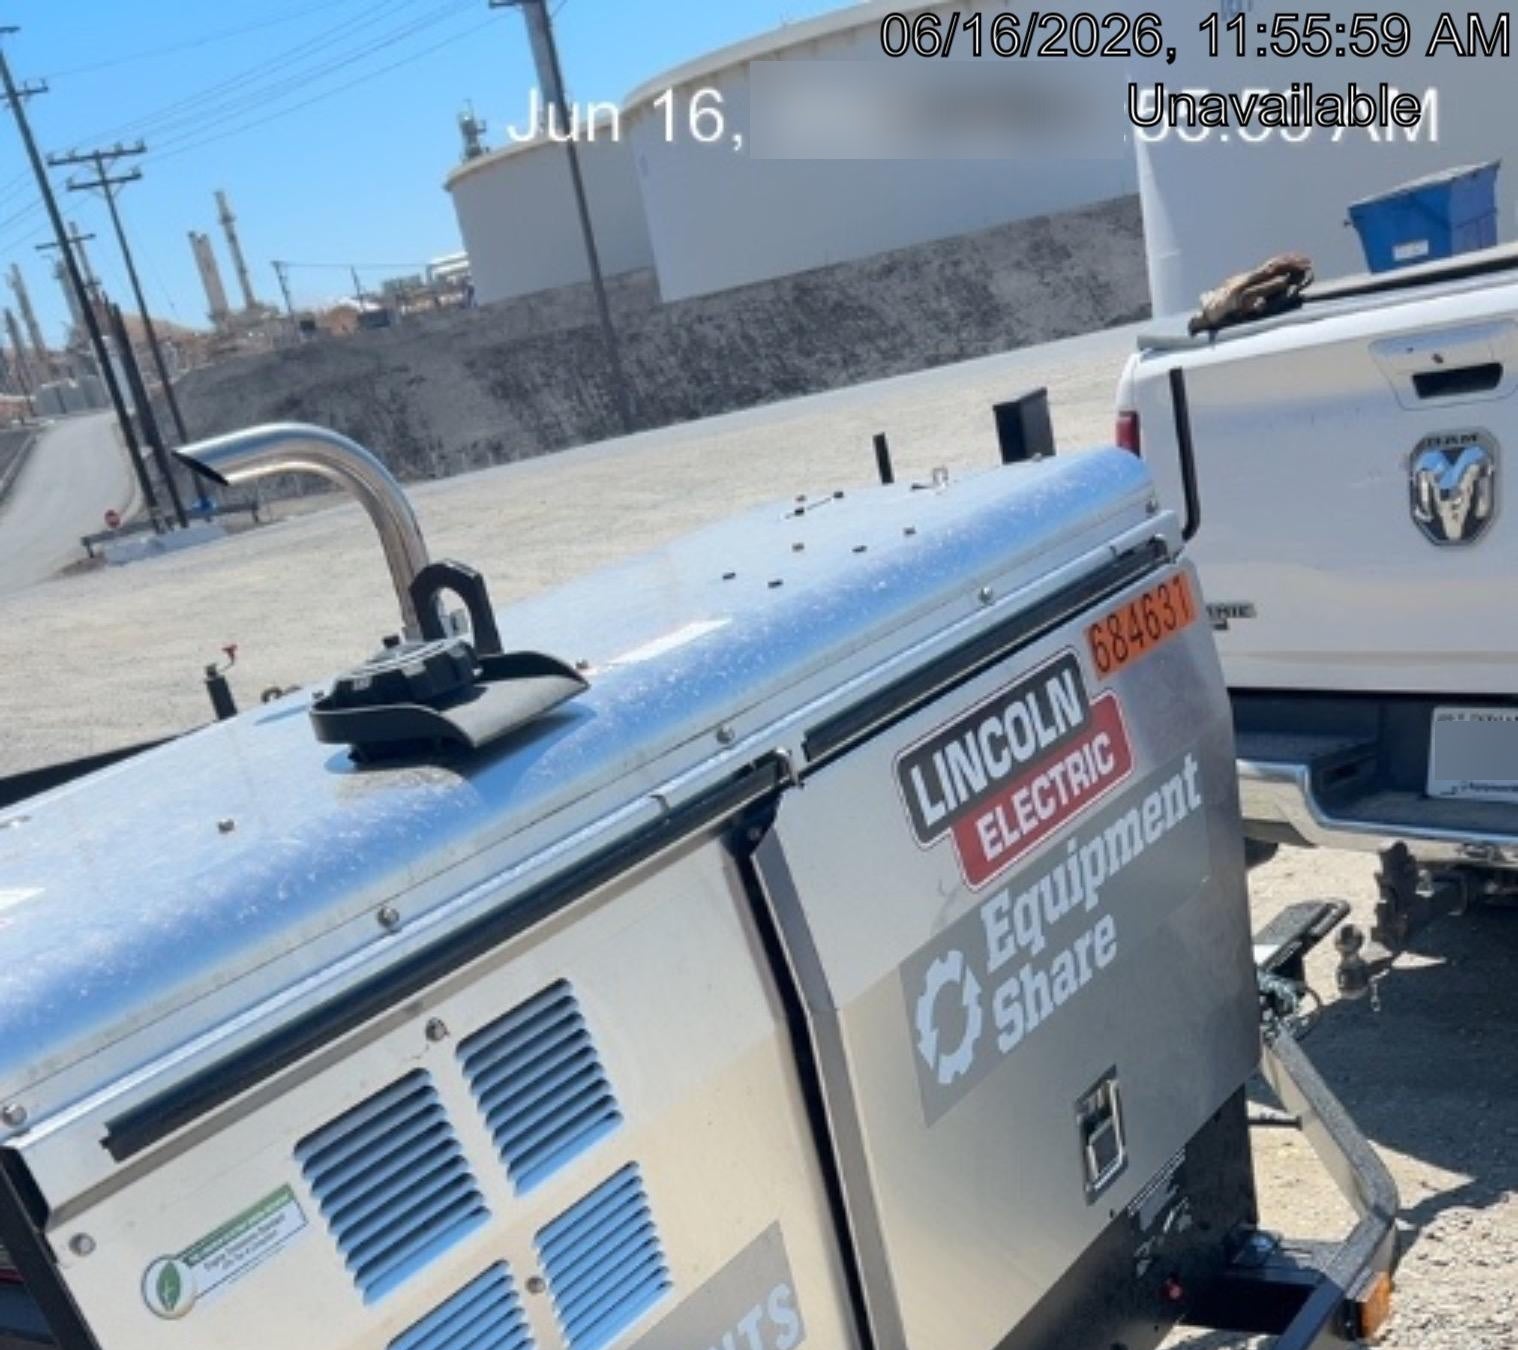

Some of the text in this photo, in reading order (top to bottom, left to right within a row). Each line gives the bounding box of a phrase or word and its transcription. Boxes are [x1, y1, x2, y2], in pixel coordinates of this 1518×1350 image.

[910, 668, 1084, 827] LINCOLN
[976, 732, 1115, 862] ELECTRIC
[980, 752, 1201, 974] Equipment
[992, 913, 1117, 1054] Share
